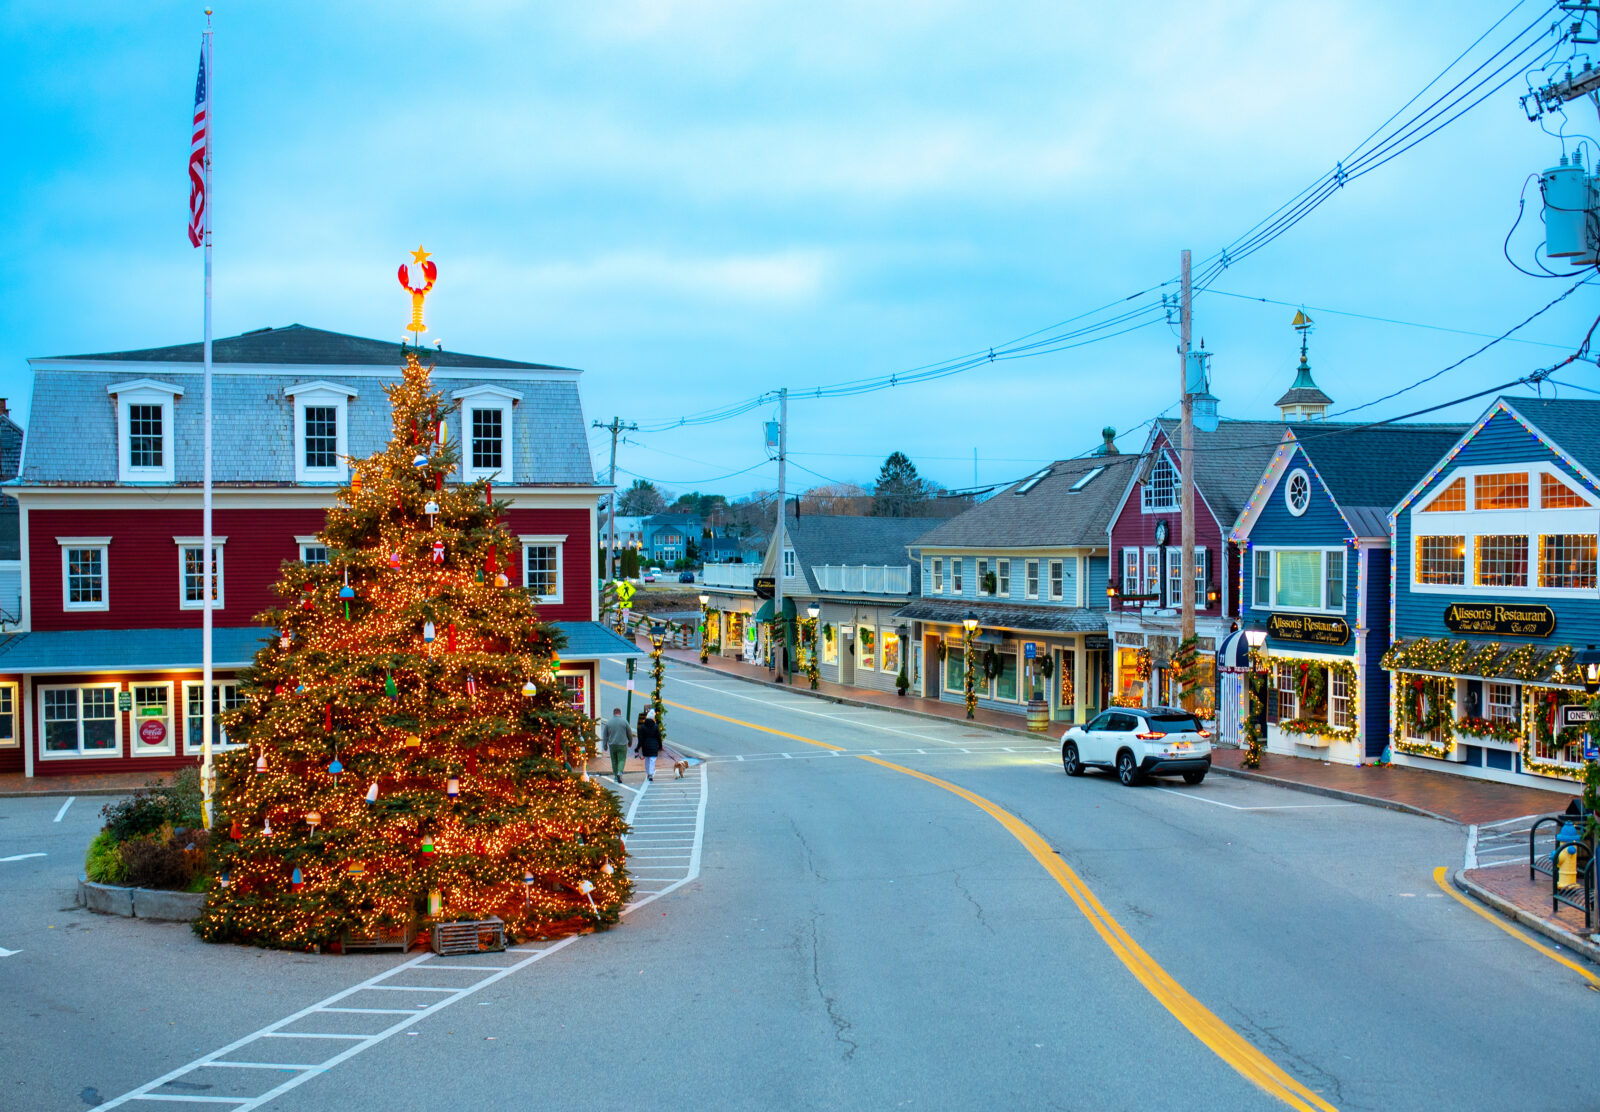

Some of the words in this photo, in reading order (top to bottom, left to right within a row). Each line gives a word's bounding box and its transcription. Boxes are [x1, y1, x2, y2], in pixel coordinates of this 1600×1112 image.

[1449, 605, 1492, 621] Alisson's
[1494, 606, 1547, 622] Restaurant
[1270, 615, 1302, 629] Alisson's
[1303, 617, 1343, 632] Restaurant
[1570, 711, 1586, 720] ONE
[142, 727, 163, 736] Coca-Cola
